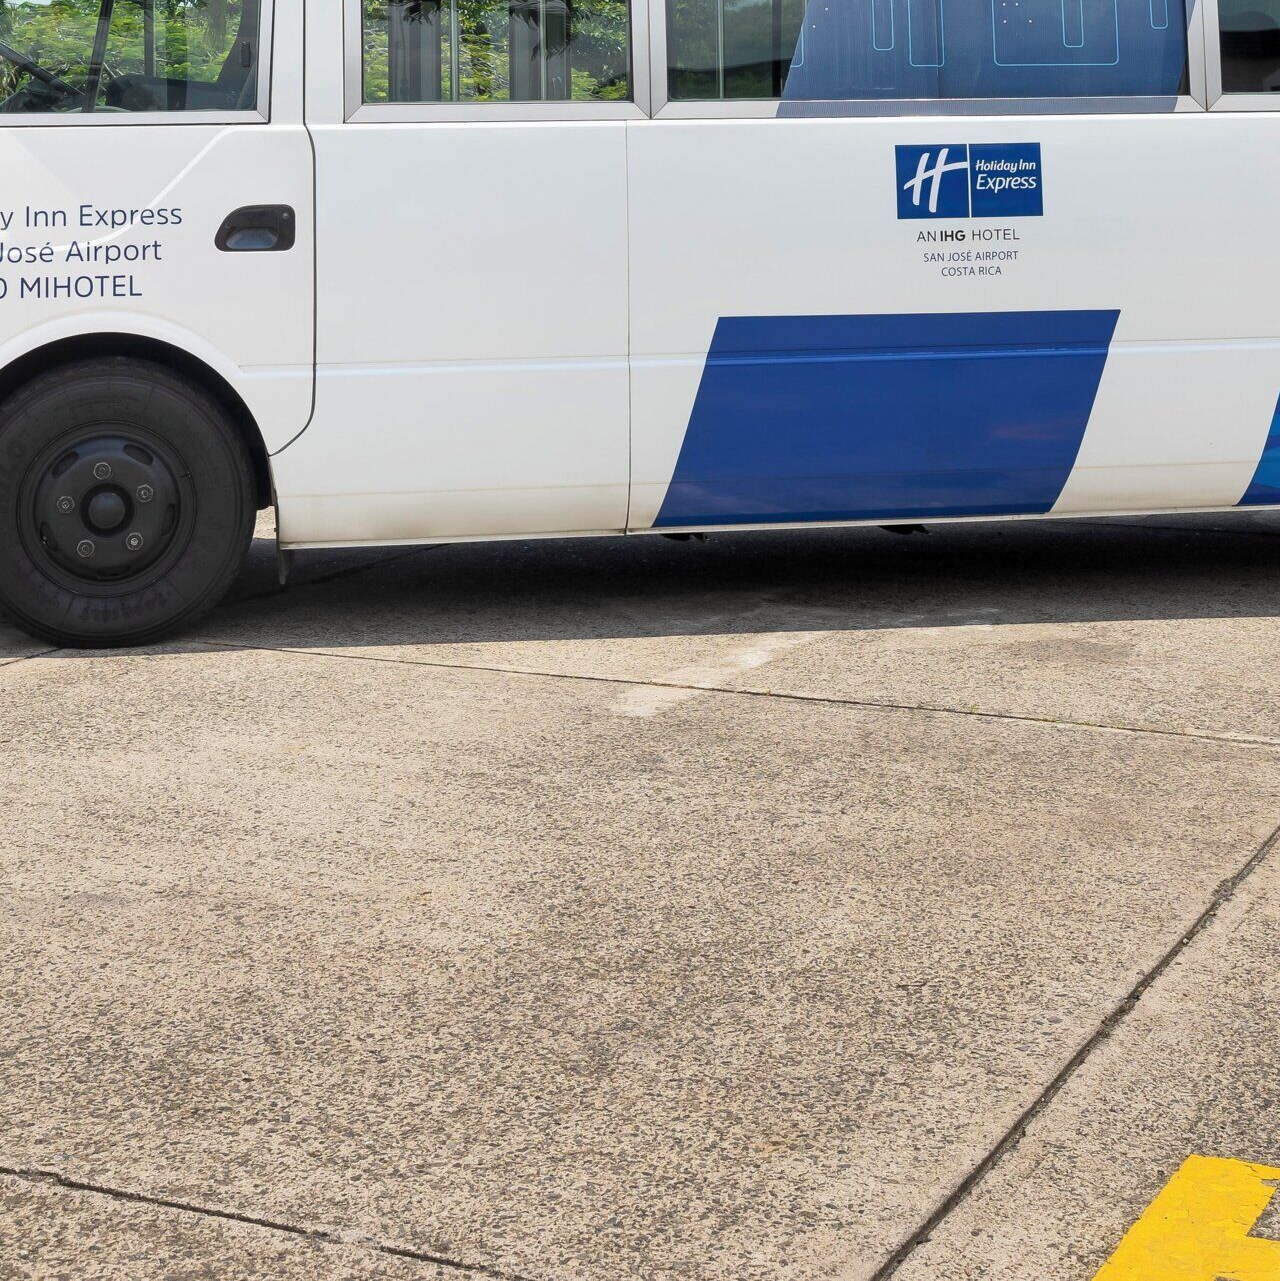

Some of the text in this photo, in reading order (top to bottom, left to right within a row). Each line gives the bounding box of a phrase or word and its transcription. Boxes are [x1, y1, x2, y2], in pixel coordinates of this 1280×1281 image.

[975, 159, 1036, 173] Holiday Inn
[976, 173, 1037, 194] Express
[25, 205, 67, 228] Inn
[78, 204, 183, 229] Express
[916, 228, 1020, 242] AN IHG HOTEL
[65, 240, 162, 265] Airport
[923, 249, 1019, 263] SAN JOSÉ AIRPORT
[941, 265, 1002, 277] COSTA RICA
[20, 274, 143, 299] MIHOTEL
